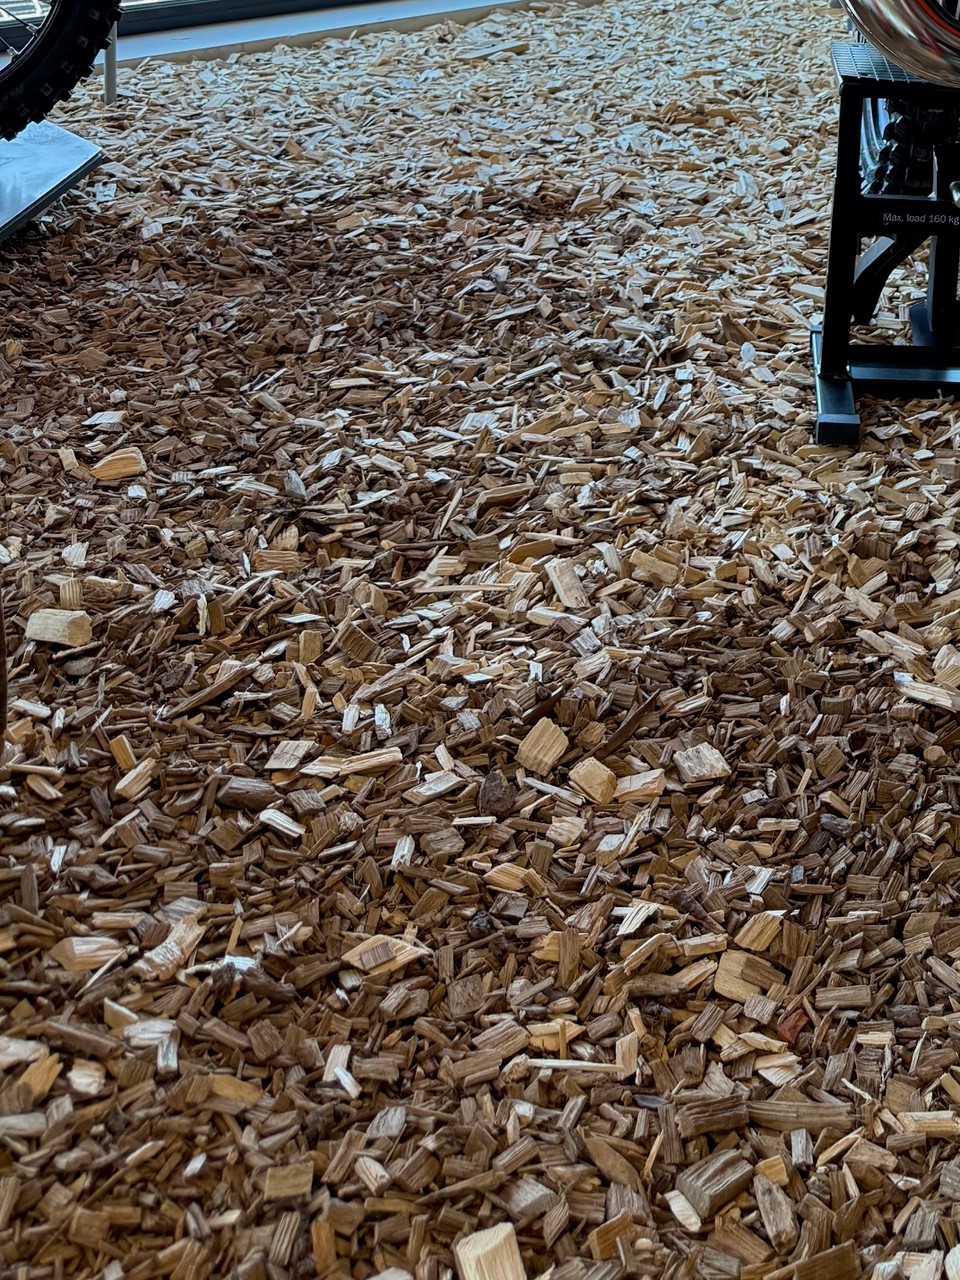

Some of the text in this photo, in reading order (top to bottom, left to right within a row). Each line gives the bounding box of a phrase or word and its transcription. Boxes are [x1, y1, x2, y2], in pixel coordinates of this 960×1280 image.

[882, 213, 904, 222] Max.
[907, 213, 926, 223] load
[929, 214, 947, 224] 160
[948, 216, 960, 226] kg
